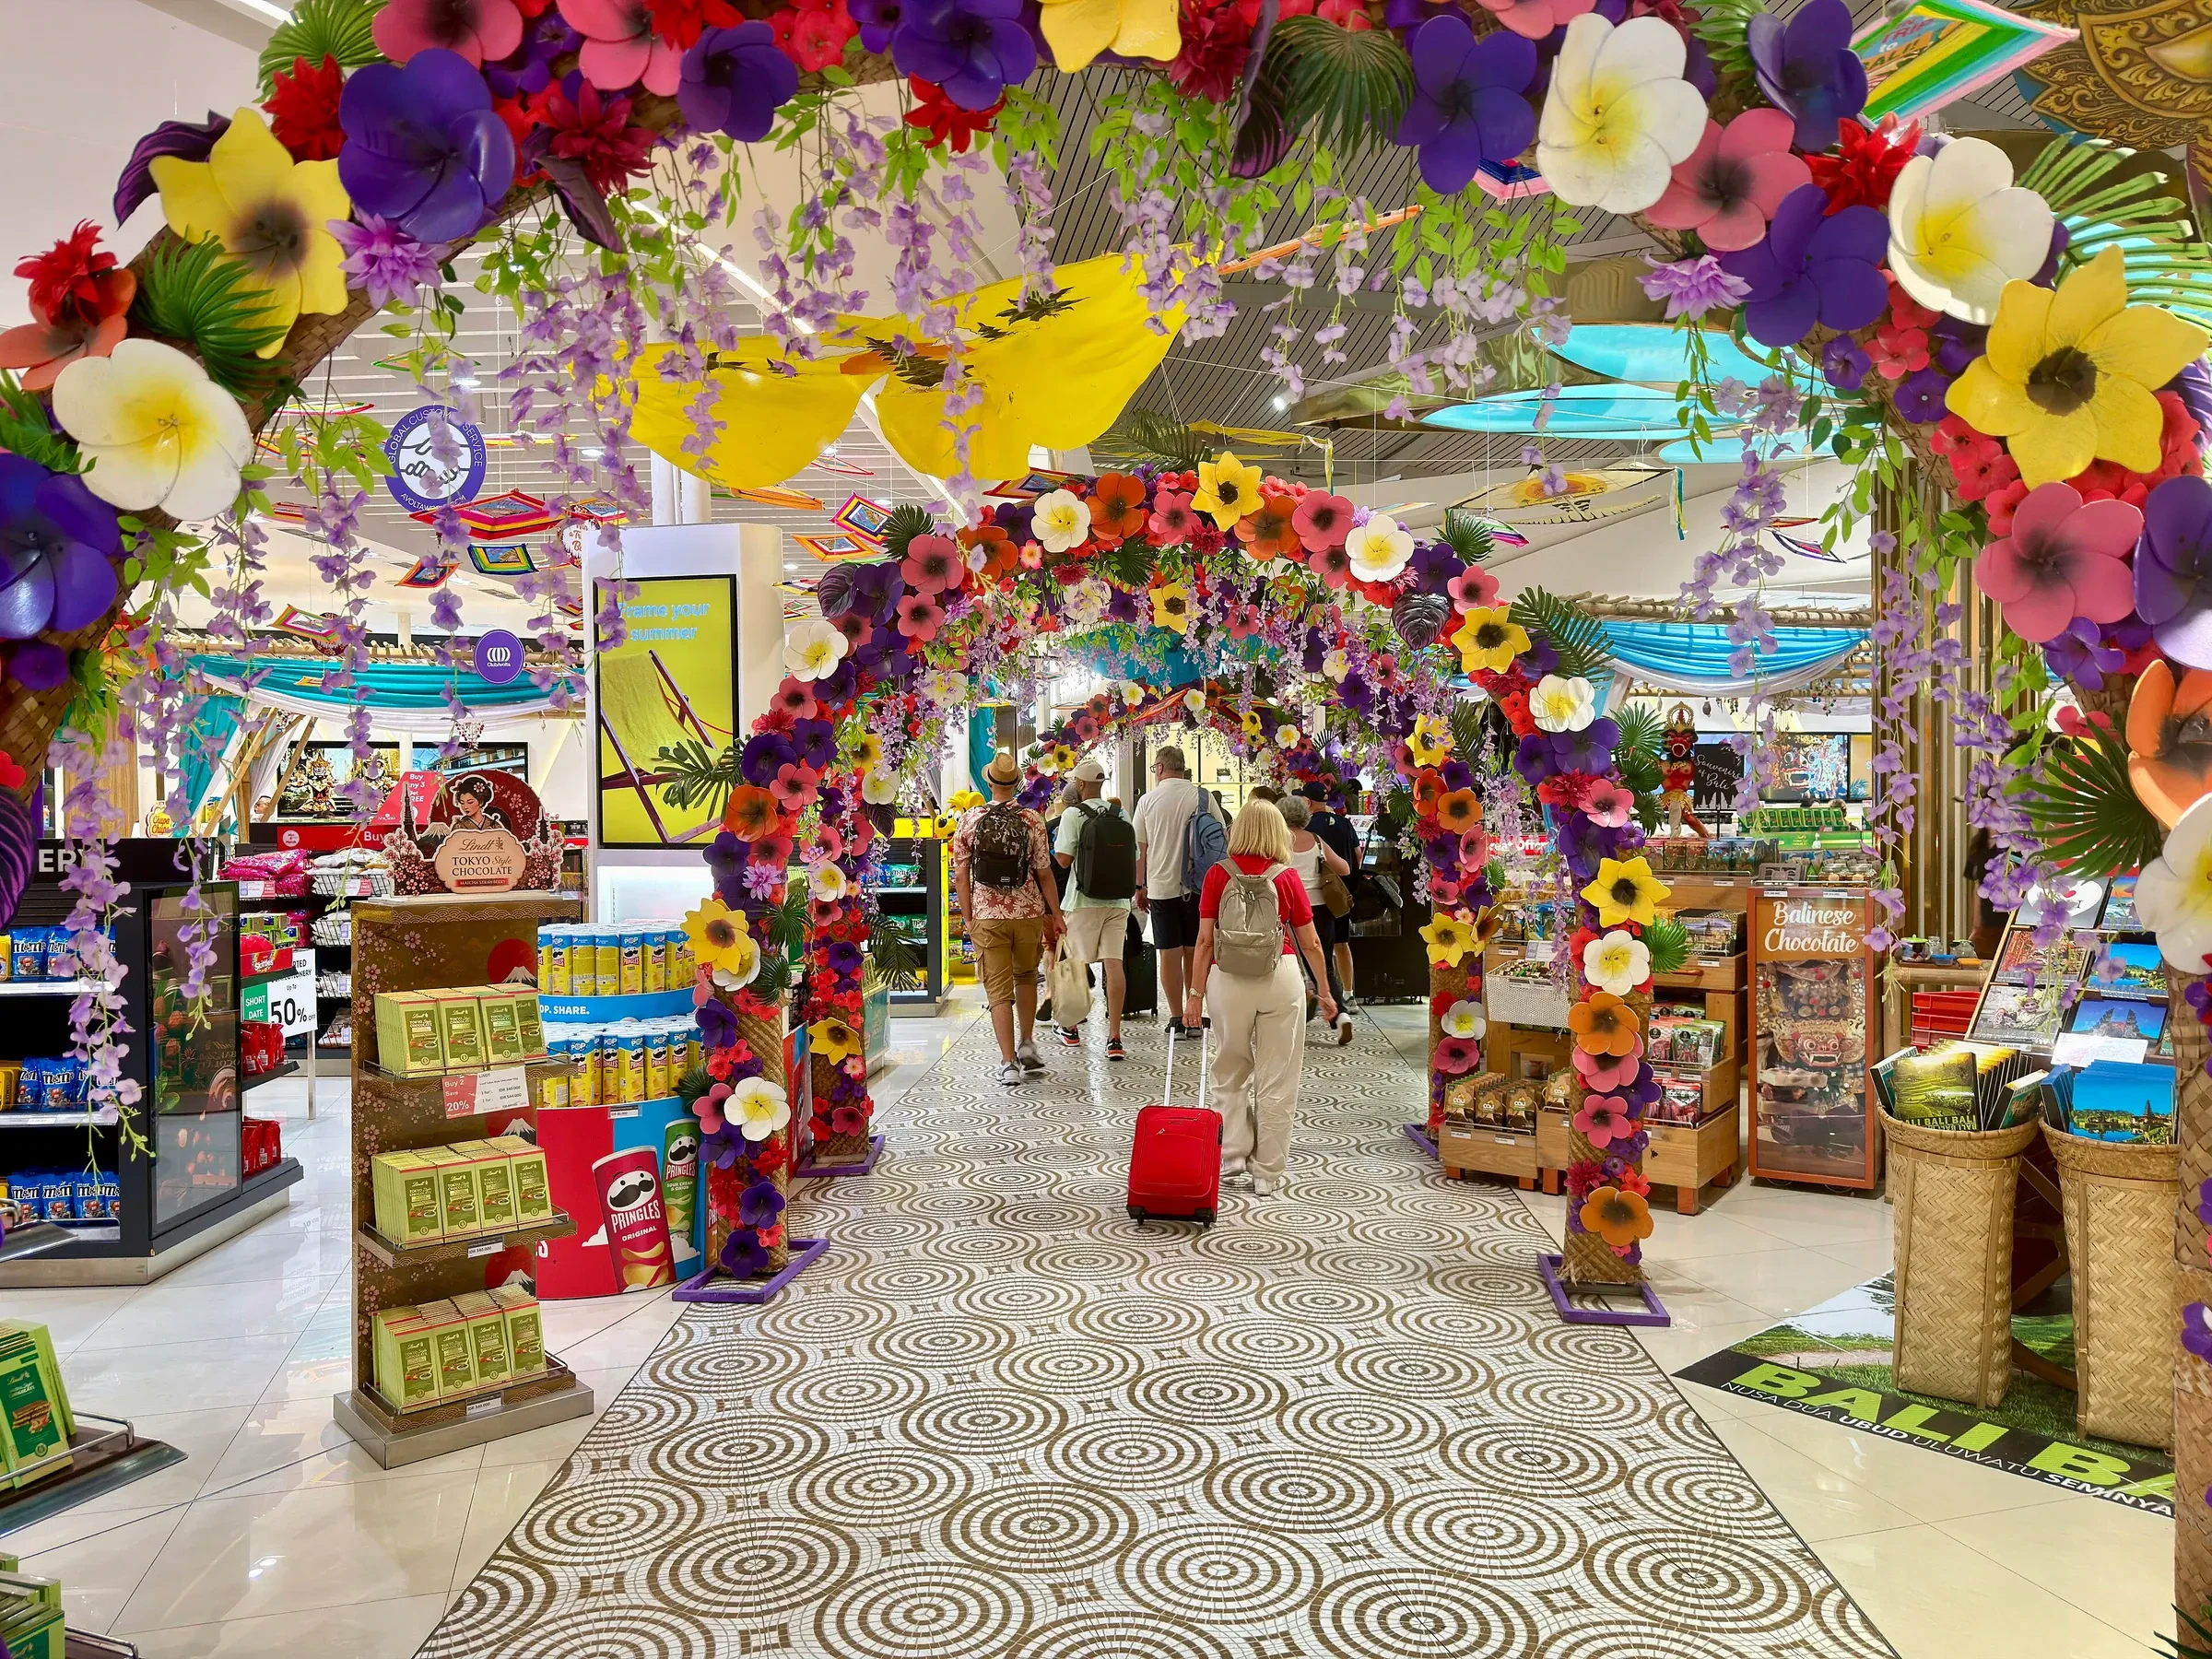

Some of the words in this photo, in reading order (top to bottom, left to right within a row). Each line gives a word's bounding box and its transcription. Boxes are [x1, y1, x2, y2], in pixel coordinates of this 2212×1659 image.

[388, 424, 411, 465] GLOBAL
[462, 422, 483, 467] SERVICE
[618, 602, 667, 618] Frame
[671, 603, 710, 621] your
[630, 627, 697, 641] summer
[1695, 754, 1740, 780] Souvenirs
[1698, 769, 1706, 777] of
[409, 773, 424, 782] Buy
[1706, 772, 1730, 790] Bali
[364, 830, 383, 845] Buy
[459, 839, 495, 851] Lindt
[452, 856, 490, 866] TOKYO
[492, 855, 512, 866] Style
[452, 866, 512, 877] CHOCOLATE
[1773, 900, 1856, 926] Balinese
[1765, 927, 1859, 953] Chocolate
[254, 959, 274, 971] Skittles
[245, 995, 266, 1006] SHORT
[249, 1008, 264, 1019] DATE
[271, 998, 307, 1026] 50%
[540, 1004, 552, 1014] OP.
[553, 1005, 590, 1015] SHARE.
[605, 1038, 617, 1046] POP
[653, 1036, 666, 1044] POP
[674, 1032, 687, 1041] POP
[571, 1042, 586, 1051] POP
[447, 1100, 469, 1112] 20%
[1924, 1117, 1947, 1125] BALI
[1952, 1115, 1976, 1124] BALI
[665, 1163, 696, 1181] PRINGLES
[611, 1199, 661, 1233] PRINGLES
[622, 1225, 657, 1241] ORIGINAL
[1730, 1363, 2009, 1452] BALI
[1721, 1382, 1778, 1404] NUSA
[1783, 1399, 1832, 1419] DUA
[1839, 1416, 1909, 1440] UBUD
[1912, 1435, 2040, 1477] ULUWATU
